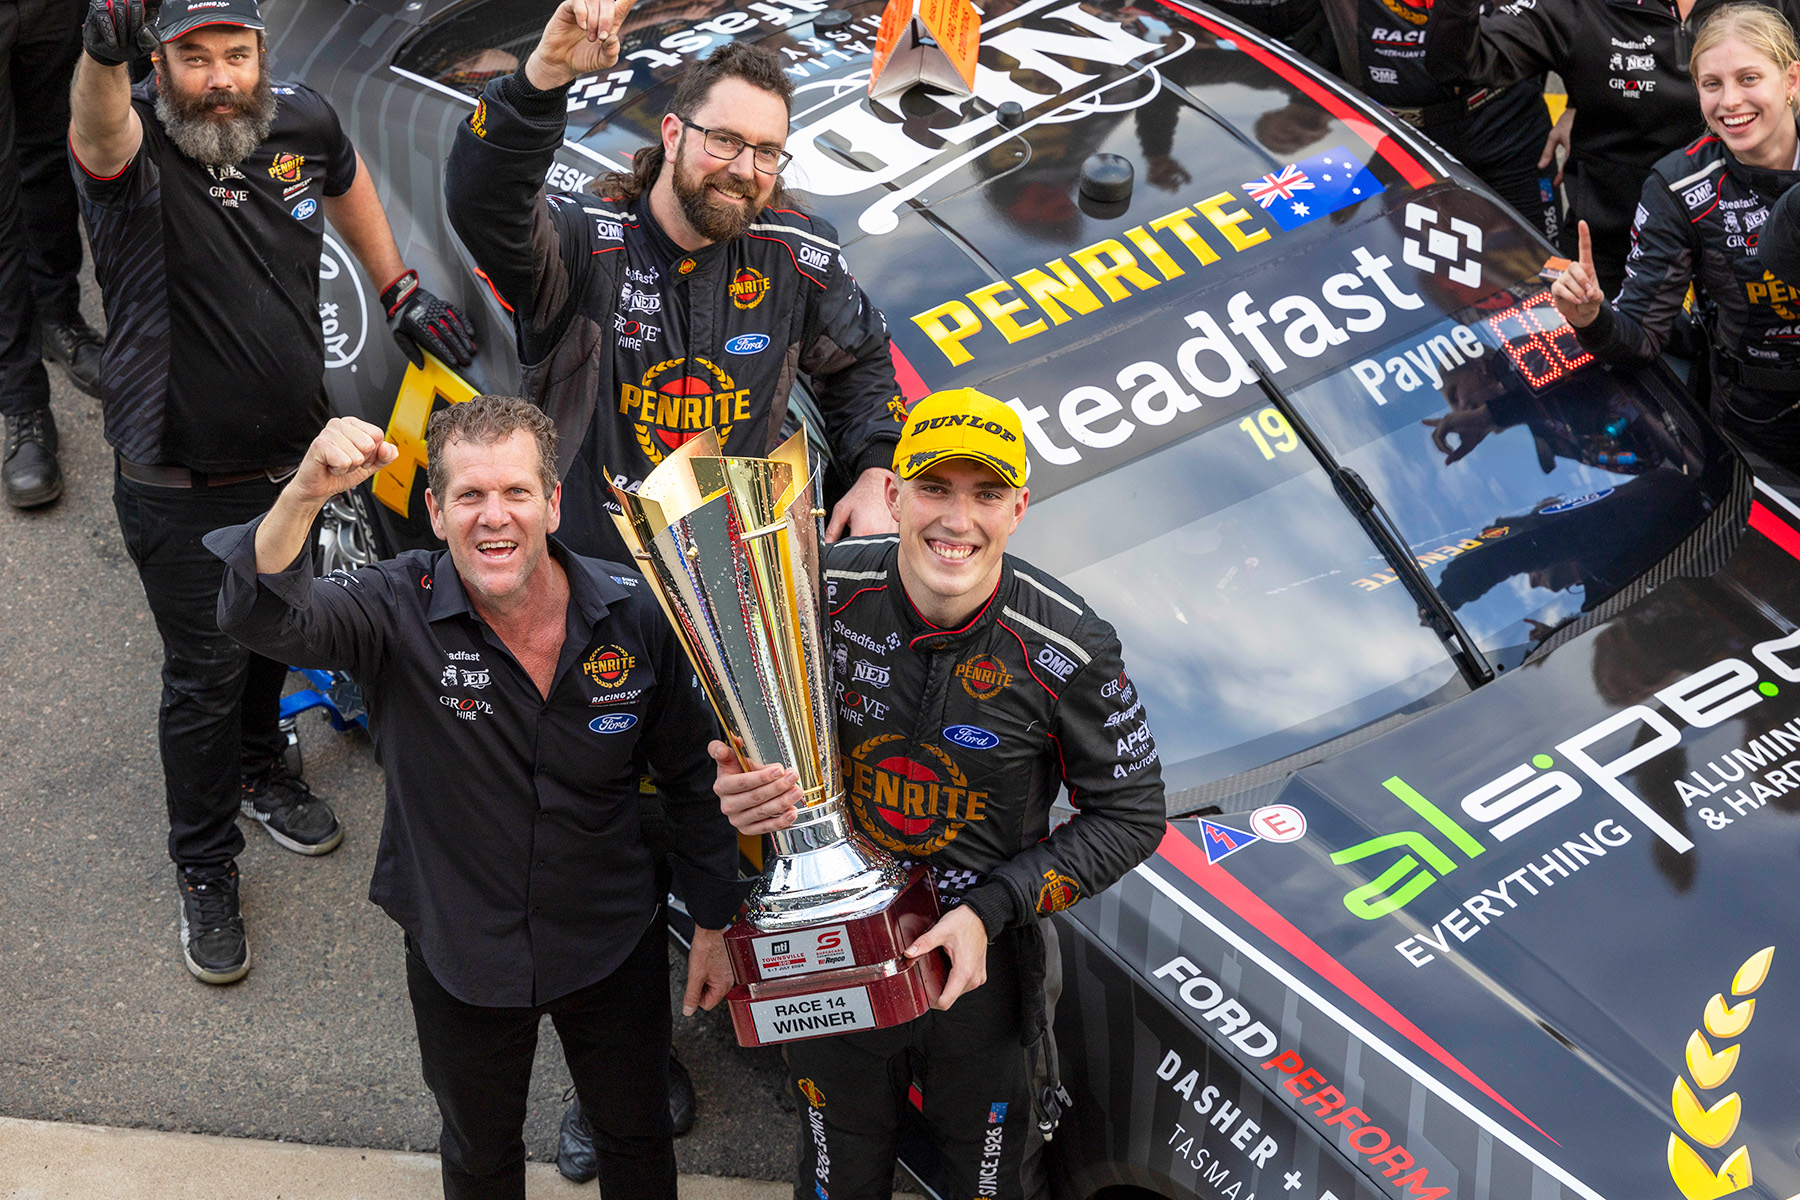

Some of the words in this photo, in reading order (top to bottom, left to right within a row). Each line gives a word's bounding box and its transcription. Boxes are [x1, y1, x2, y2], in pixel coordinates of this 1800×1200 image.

[1371, 26, 1427, 45] RACI
[1627, 56, 1656, 69] NED
[1369, 69, 1399, 82] OMP
[1608, 78, 1655, 92] GROVE
[1623, 90, 1641, 99] HIRE
[268, 155, 305, 179] PENRITE
[1684, 182, 1714, 207] OMP
[1726, 233, 1759, 248] GRO
[800, 246, 830, 267] OMP
[910, 190, 1273, 368] PENRITE
[631, 295, 661, 310] NED
[618, 335, 643, 351] HIRE
[734, 335, 763, 352] Ford
[1003, 246, 1425, 482] teadfast
[1350, 323, 1486, 407] Payne
[619, 382, 751, 431] PENRITE
[911, 414, 1017, 443] DUNLOP
[1238, 407, 1299, 462] 19
[833, 619, 887, 656] Steadfast
[447, 650, 480, 661] adfast
[582, 656, 636, 675] PENRITE
[1037, 648, 1076, 677] OMP
[854, 662, 891, 686] NED
[955, 664, 1014, 688] PENRITE
[439, 695, 494, 715] GROVE
[591, 692, 627, 704] RACING
[834, 680, 886, 722] ROVE
[456, 711, 477, 721] HIRE
[598, 716, 630, 731] Ford
[839, 704, 864, 727] HIRE
[953, 726, 990, 747] Ford
[1261, 813, 1296, 836] E
[1698, 807, 1734, 831] &
[1394, 817, 1633, 969] EVERYTHING
[762, 952, 805, 963] TOWNSVILLE
[773, 942, 788, 954] nti
[825, 956, 846, 965] Repco
[775, 1000, 822, 1018] RACE
[828, 996, 847, 1010] 14
[773, 1010, 856, 1036] WINNER
[1152, 956, 1279, 1059] FORD
[1260, 1048, 1451, 1200] PERFORM
[1156, 1049, 1279, 1170] DASHER
[983, 1126, 1003, 1158] 1926
[978, 1158, 998, 1198] SINCE
